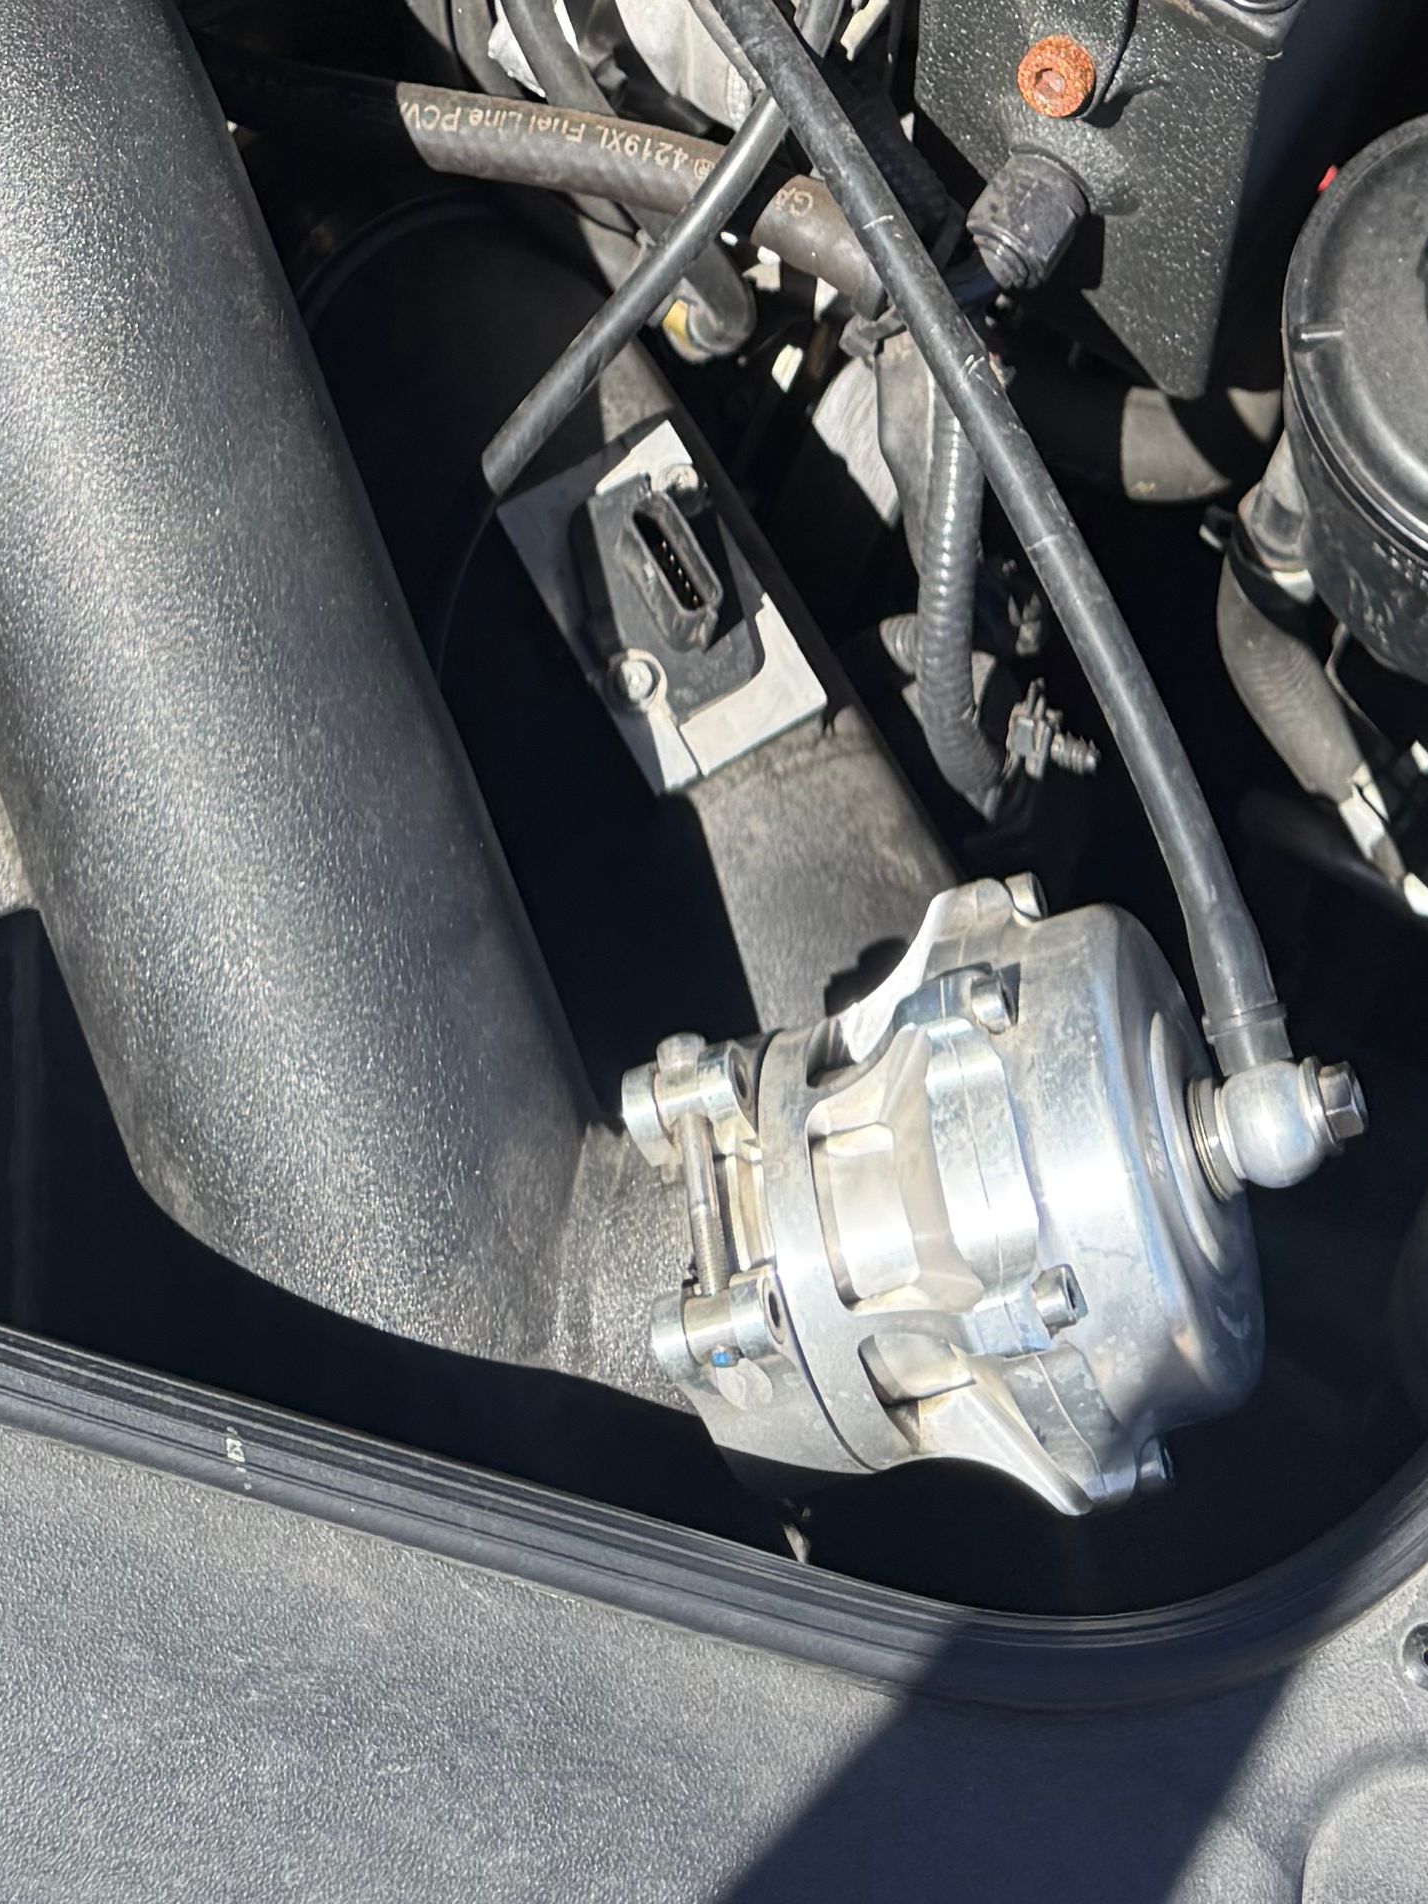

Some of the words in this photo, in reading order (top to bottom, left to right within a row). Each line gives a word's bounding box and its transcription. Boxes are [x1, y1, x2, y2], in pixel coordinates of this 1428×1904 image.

[469, 108, 524, 133] Line
[528, 114, 587, 144] Fuel
[595, 125, 689, 172] 4219XL
